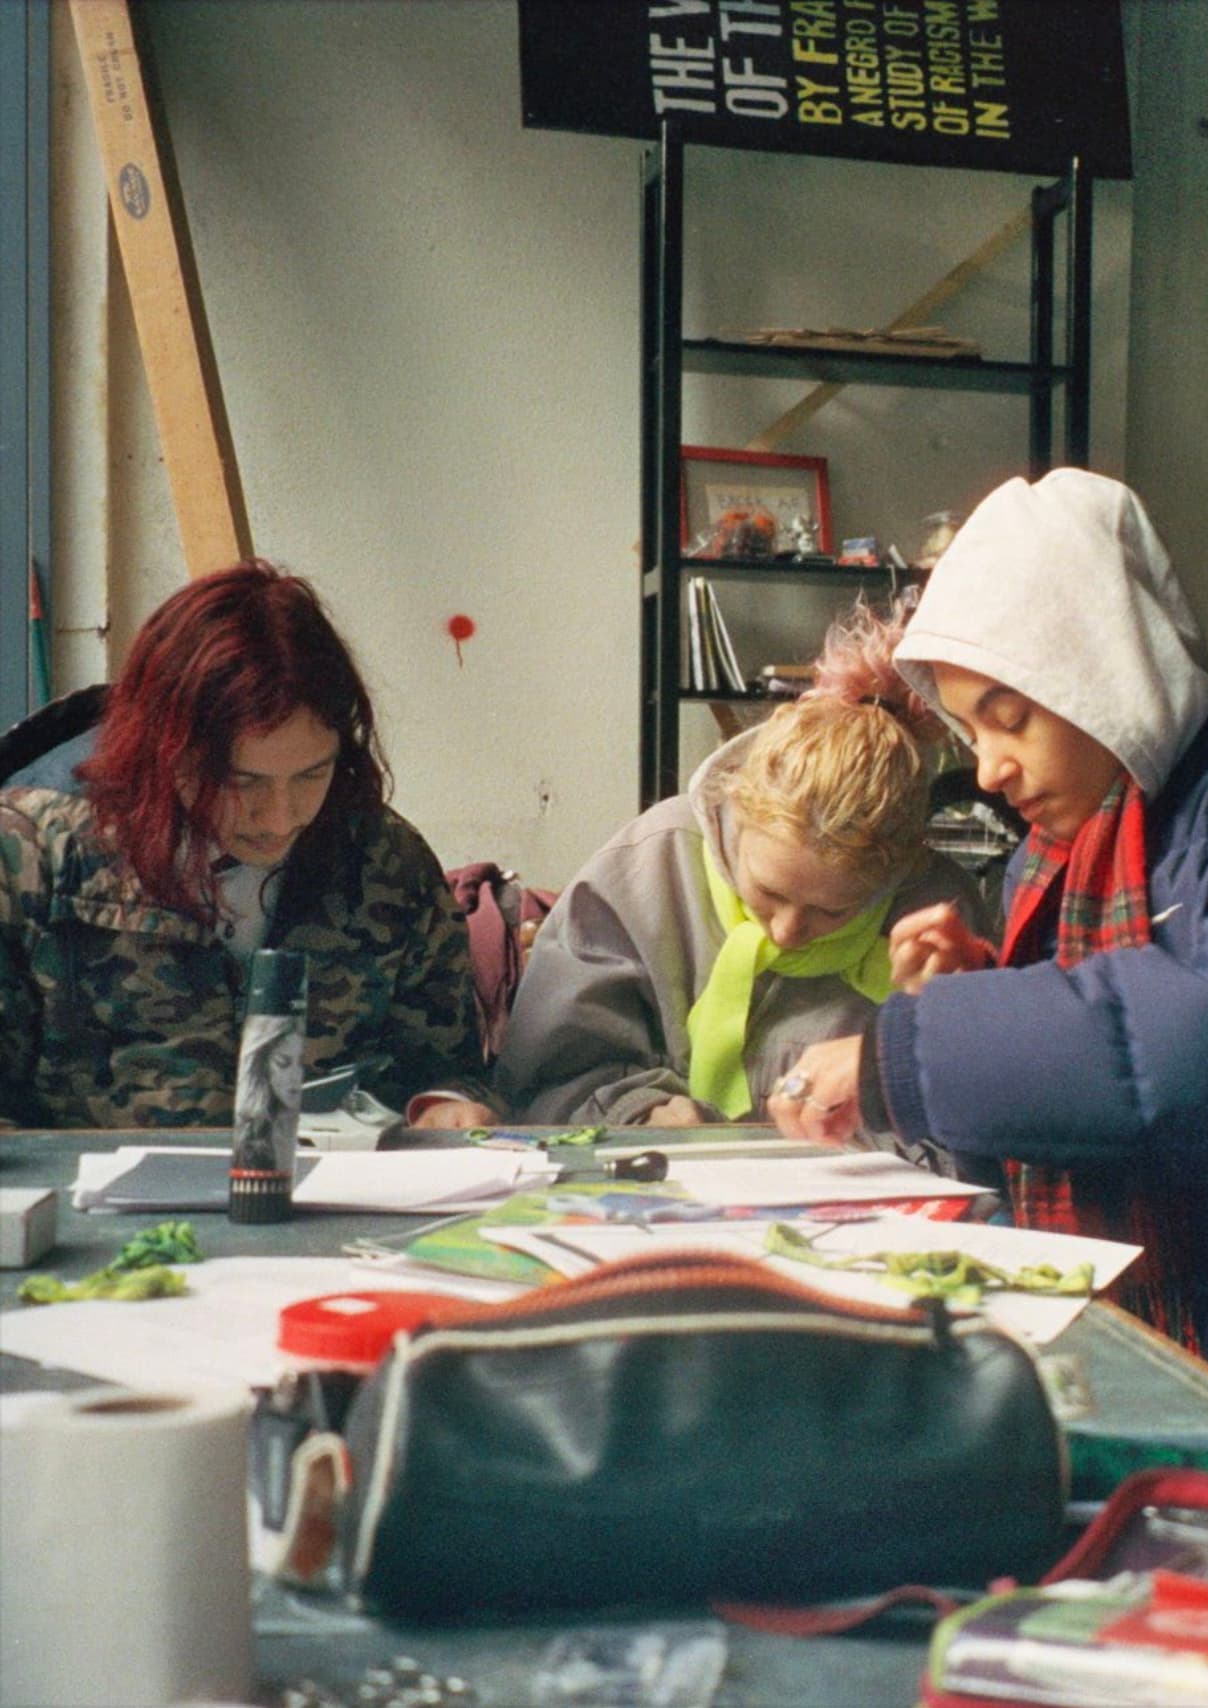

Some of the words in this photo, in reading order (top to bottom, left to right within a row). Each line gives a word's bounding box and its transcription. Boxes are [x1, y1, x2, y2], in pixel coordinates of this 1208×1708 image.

[882, 4, 921, 37] OF
[924, 0, 967, 95] RACISM
[649, 33, 716, 114] THE
[845, 19, 884, 105] NEGRO
[969, 30, 1006, 87] THE
[722, 57, 789, 119] OF
[795, 75, 843, 125] BY
[885, 45, 927, 131] STUDY
[852, 111, 885, 127] A
[932, 100, 970, 136] OF
[974, 101, 1011, 139] IN
